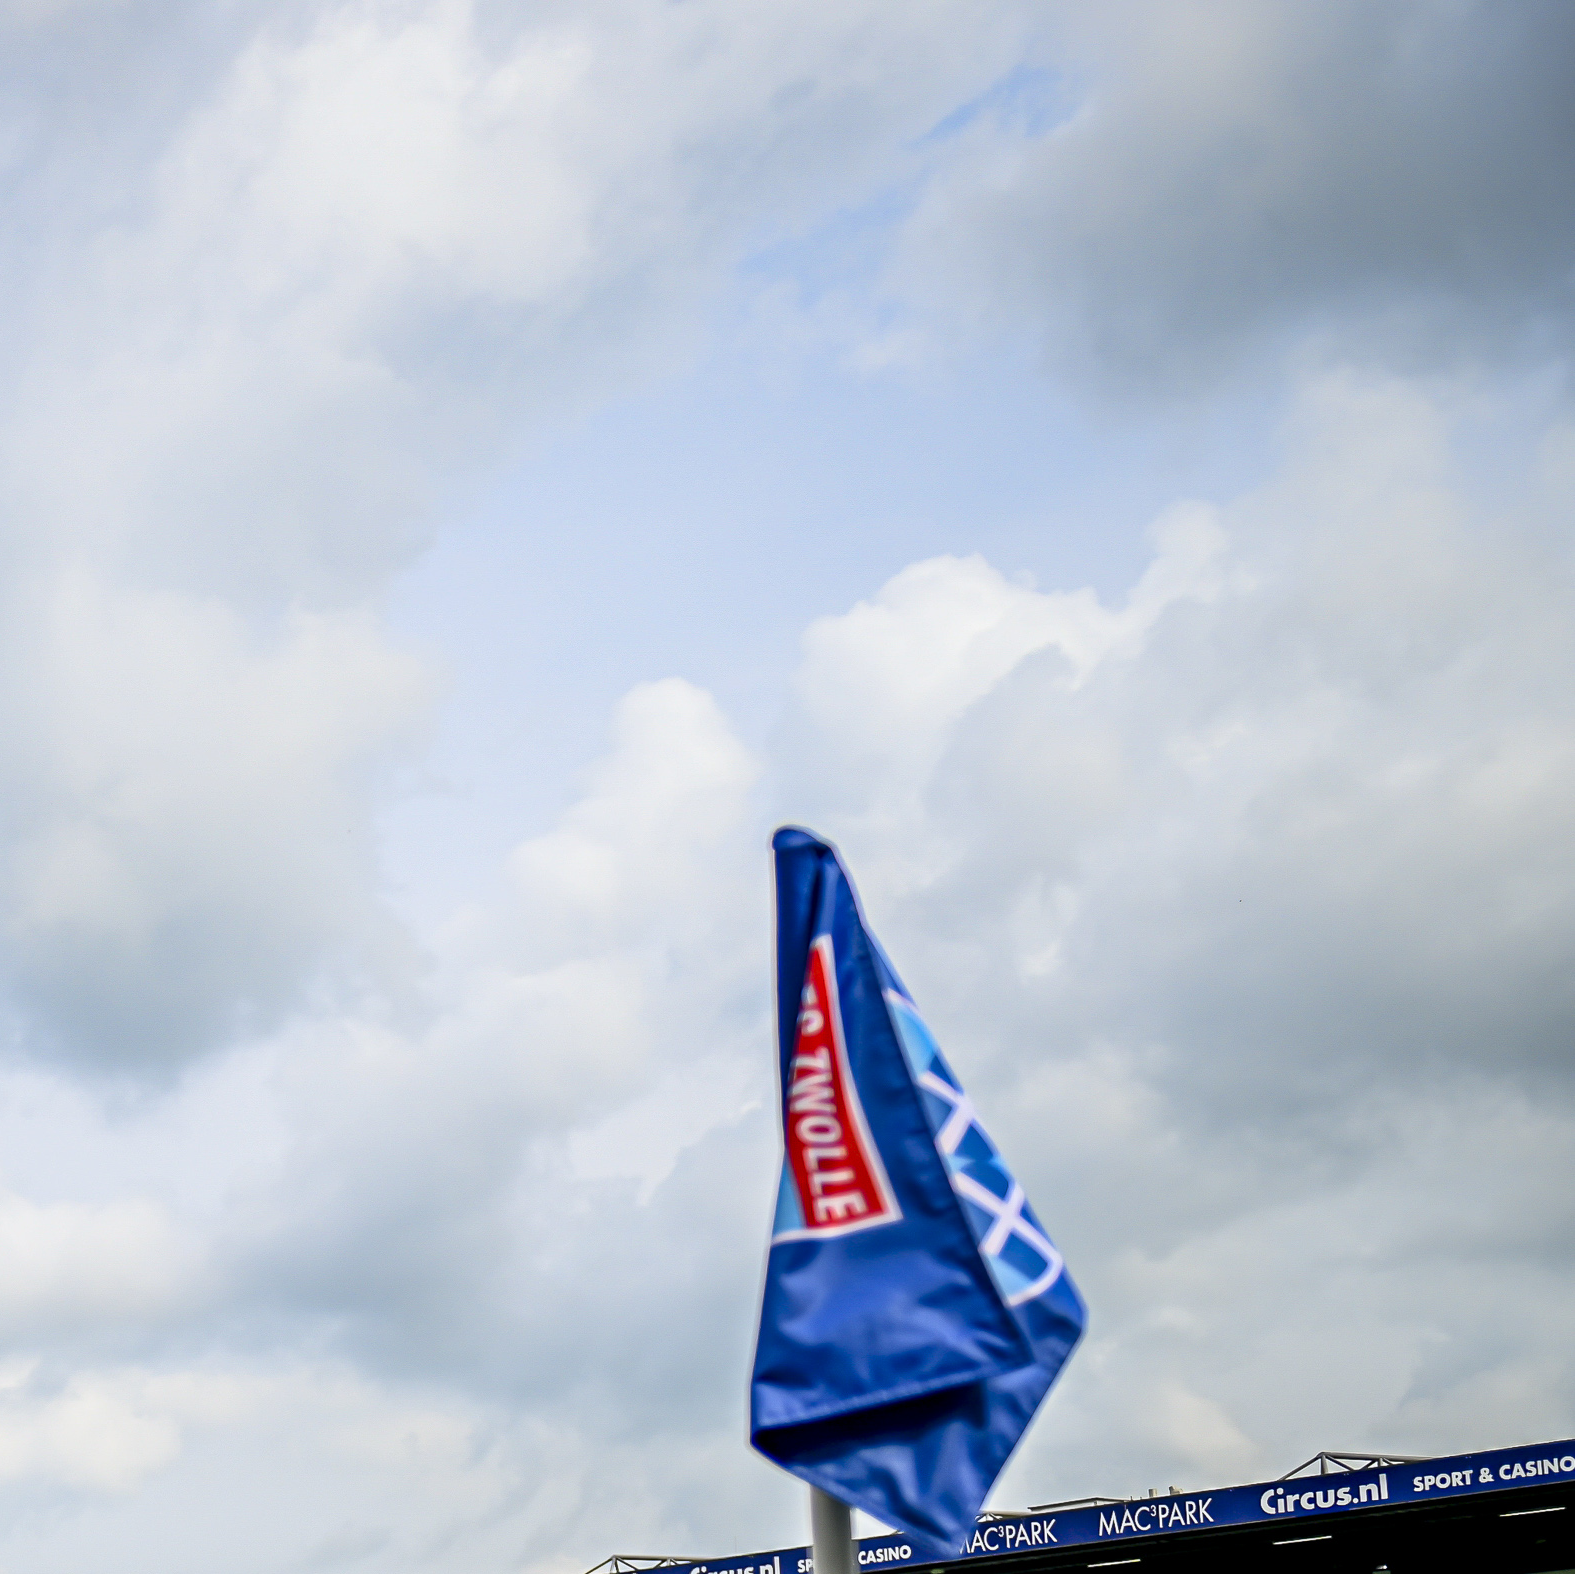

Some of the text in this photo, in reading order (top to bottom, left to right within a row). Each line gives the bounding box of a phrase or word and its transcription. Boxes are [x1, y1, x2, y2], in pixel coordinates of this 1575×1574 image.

[1260, 1455, 1575, 1515] Circus.nl SPORT & CASINO
[857, 1545, 912, 1565] CASINO
